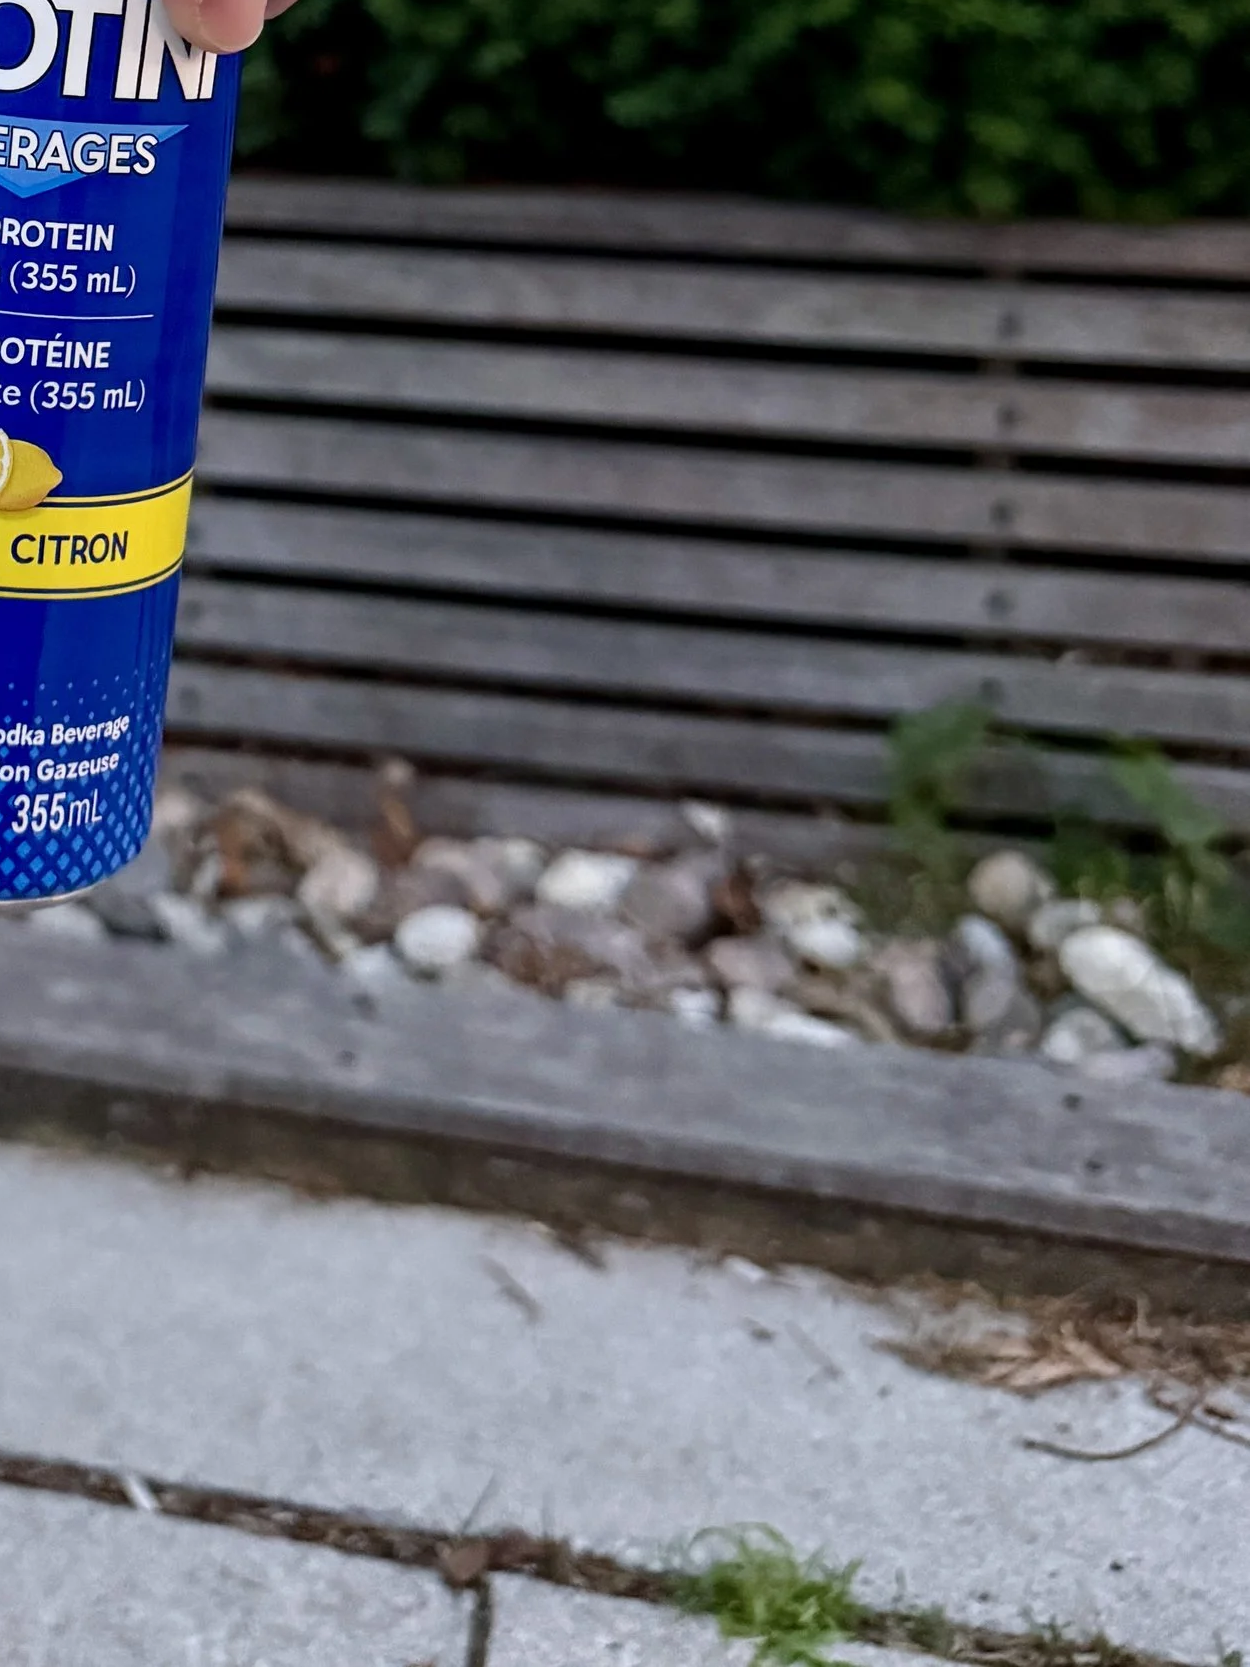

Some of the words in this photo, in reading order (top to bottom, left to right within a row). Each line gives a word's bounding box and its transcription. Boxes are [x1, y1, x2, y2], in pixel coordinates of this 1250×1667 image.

[9, 260, 79, 295] (355
[86, 264, 137, 299] mL)
[29, 379, 96, 415] (355
[102, 378, 146, 413] mL)
[10, 530, 129, 566] CITRON
[50, 715, 130, 746] Beverage
[36, 752, 120, 782] Gazeuse
